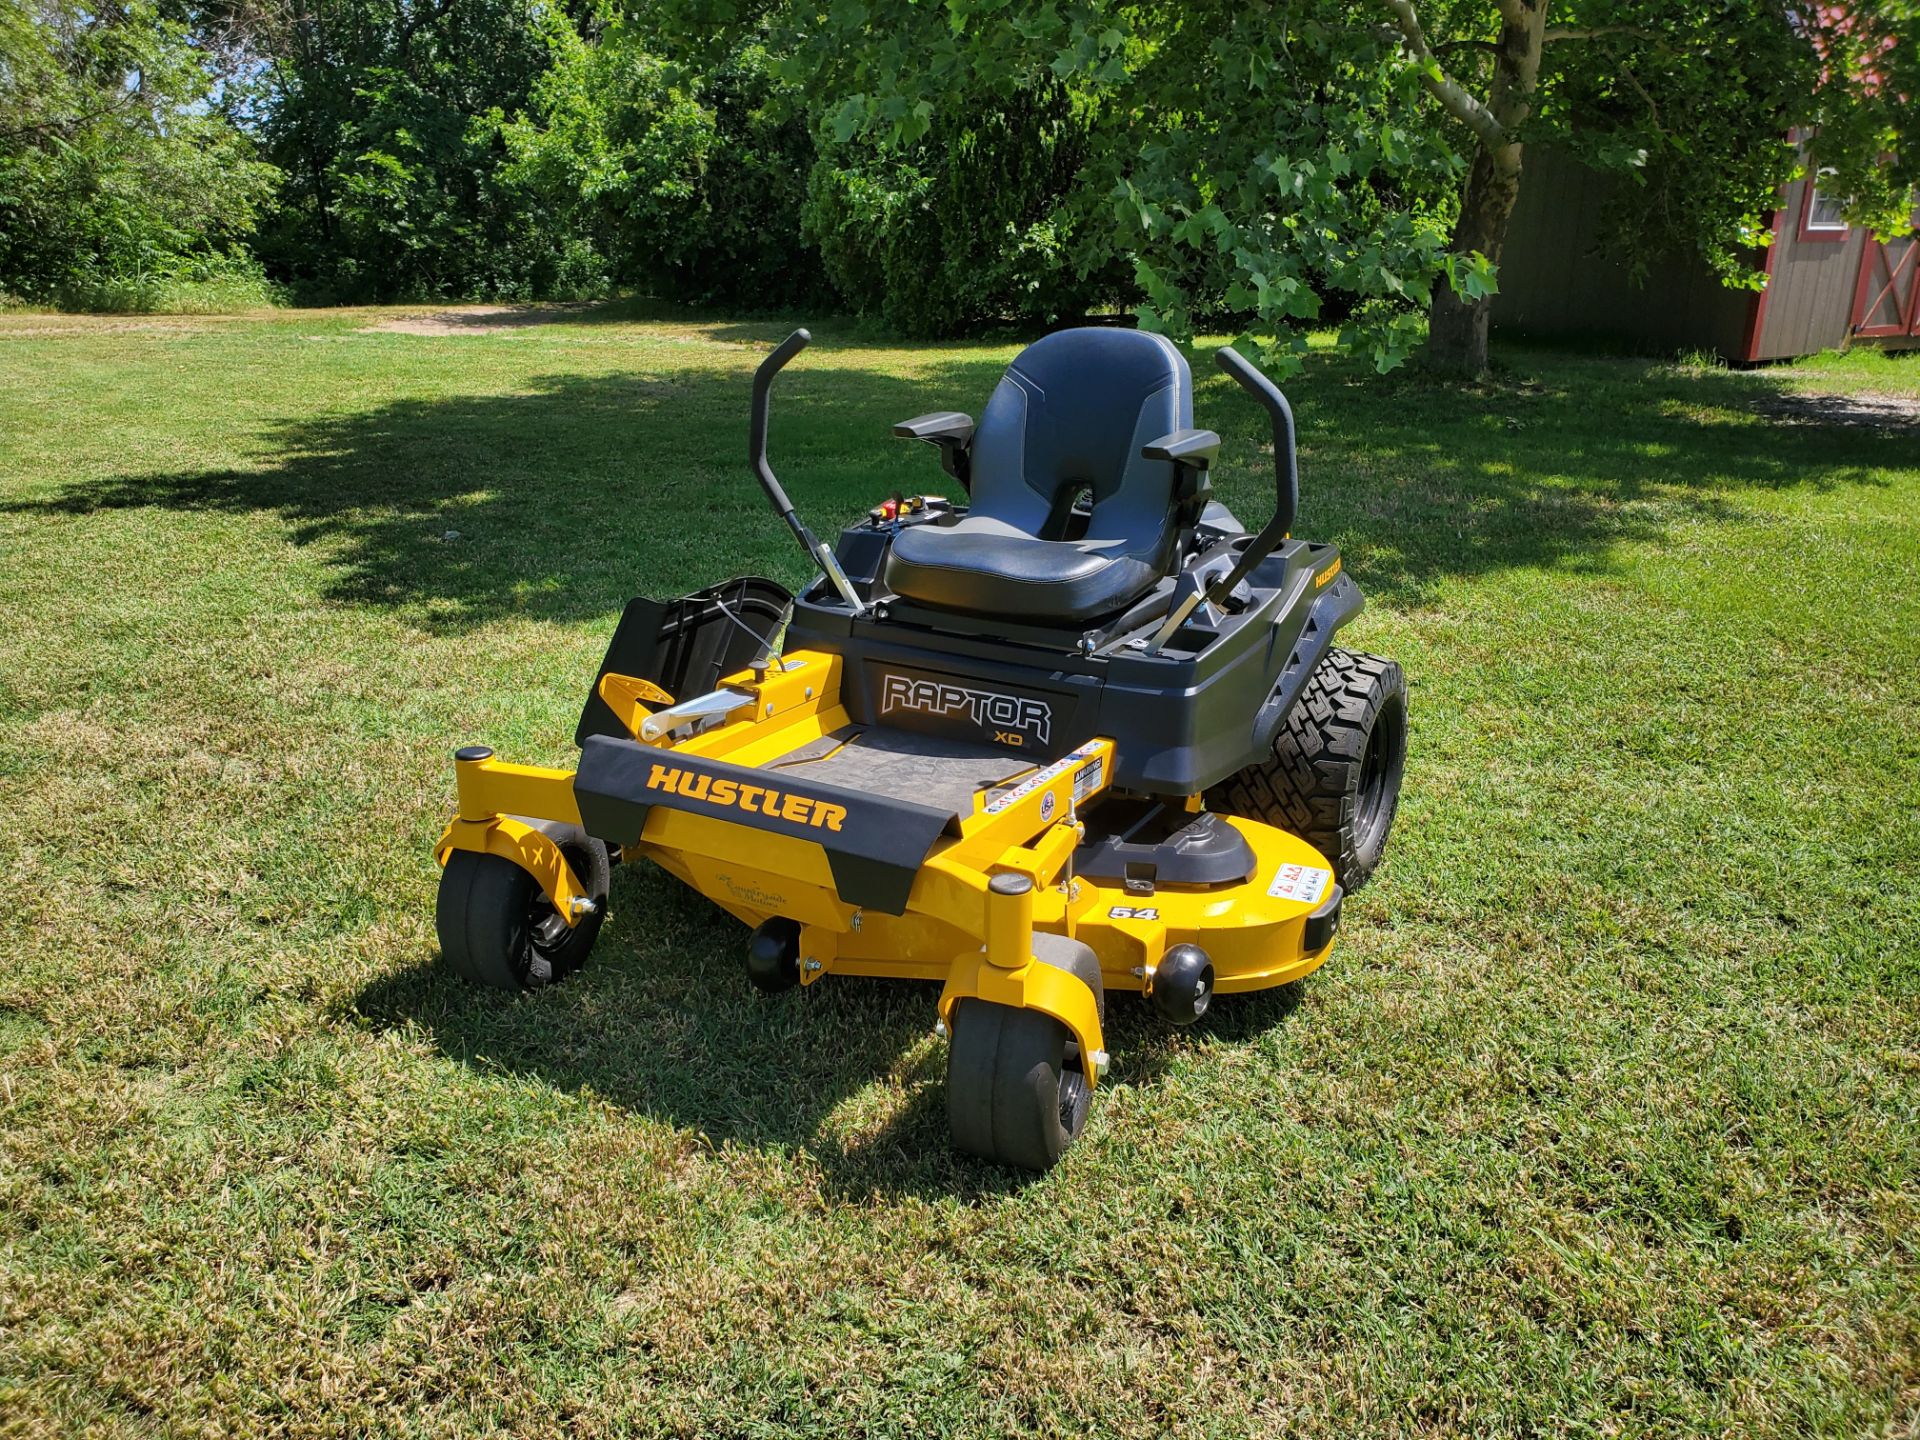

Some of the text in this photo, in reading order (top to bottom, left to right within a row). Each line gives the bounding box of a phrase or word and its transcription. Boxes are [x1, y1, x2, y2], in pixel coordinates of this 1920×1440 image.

[882, 674, 1052, 746] RAPTOR
[993, 730, 1023, 746] XD
[646, 764, 848, 832] HUSTLER
[1107, 906, 1160, 921] 54
